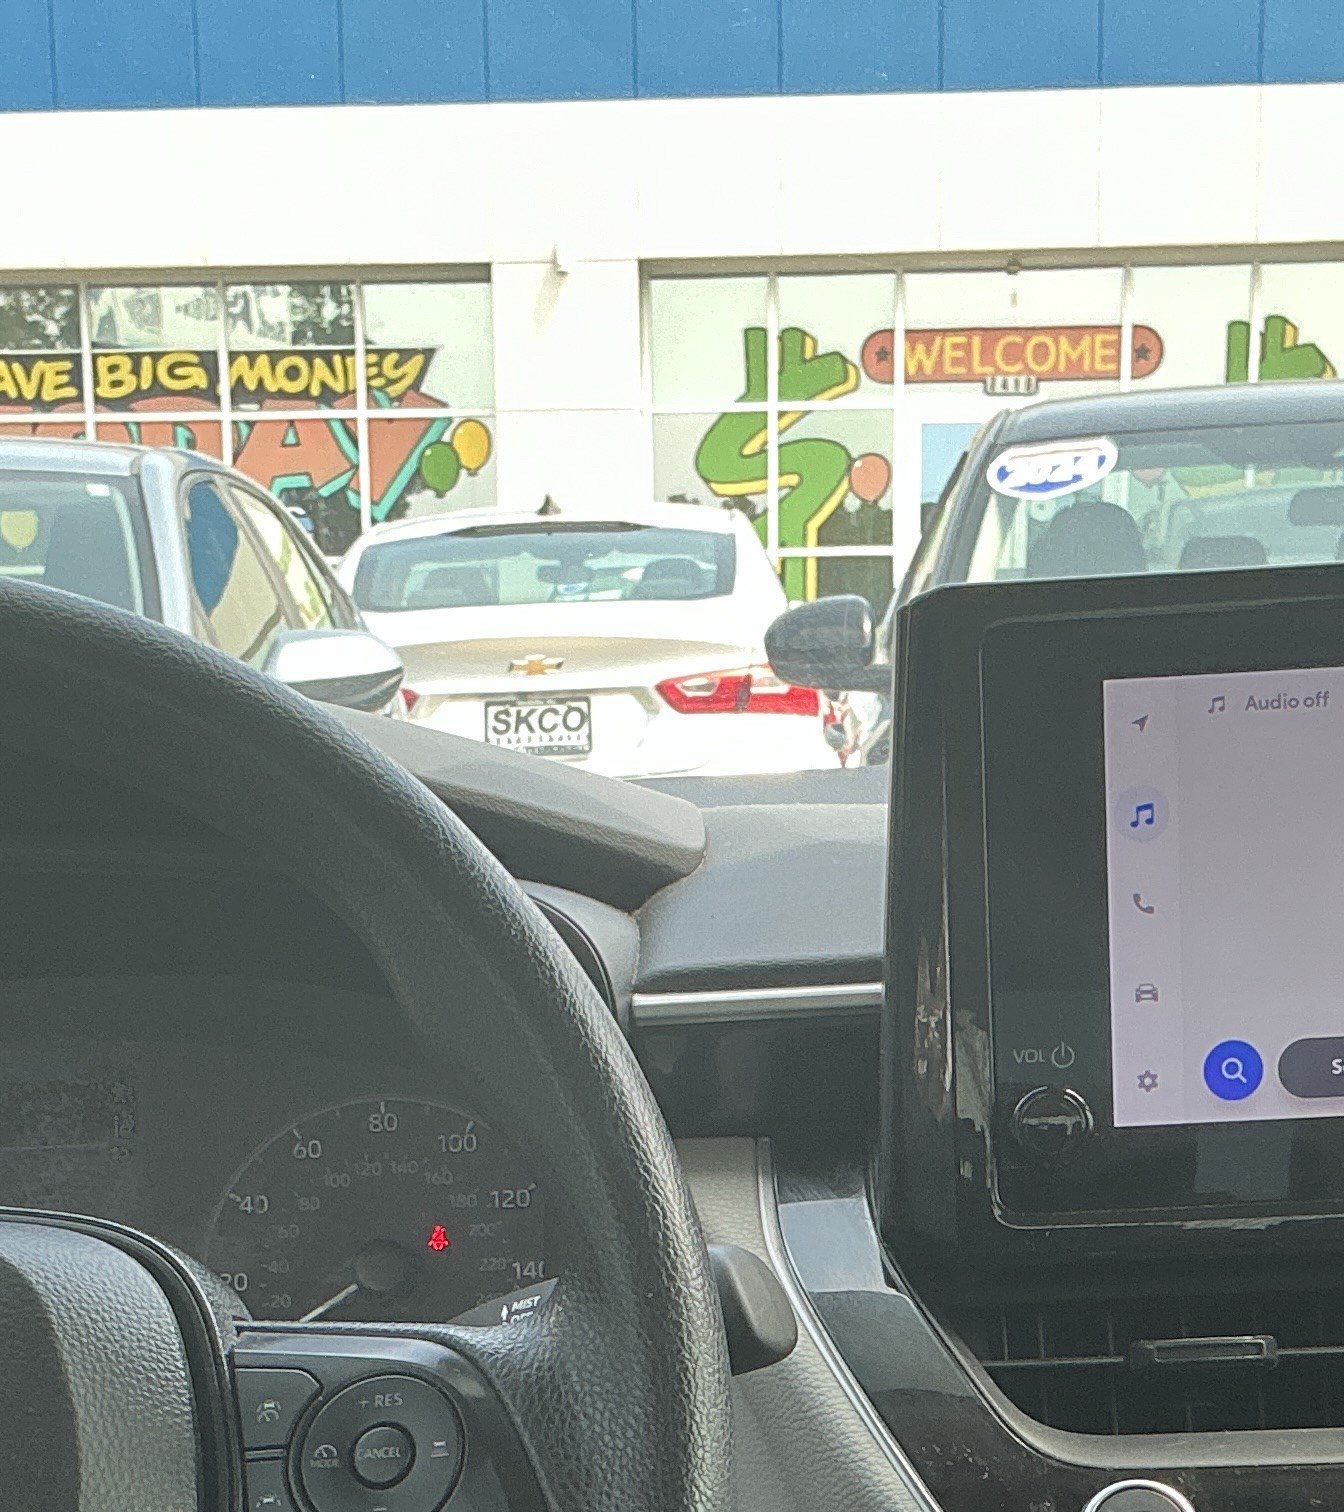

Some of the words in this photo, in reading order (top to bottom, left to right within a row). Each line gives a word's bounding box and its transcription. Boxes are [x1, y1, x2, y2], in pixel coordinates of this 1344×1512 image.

[904, 332, 1120, 377] WELCOME
[95, 351, 209, 399] BIG
[214, 352, 426, 399] MONEY
[1244, 693, 1300, 712] Audio
[1302, 690, 1331, 709] off
[492, 706, 586, 735] SKCO
[1012, 1048, 1046, 1064] VOL
[368, 1113, 398, 1133] 80
[292, 1139, 323, 1160] 60
[437, 1133, 477, 1154] 100
[238, 1194, 269, 1214] 40
[491, 1189, 530, 1209] 120
[511, 1294, 542, 1313] MIST
[374, 1392, 405, 1408] RES
